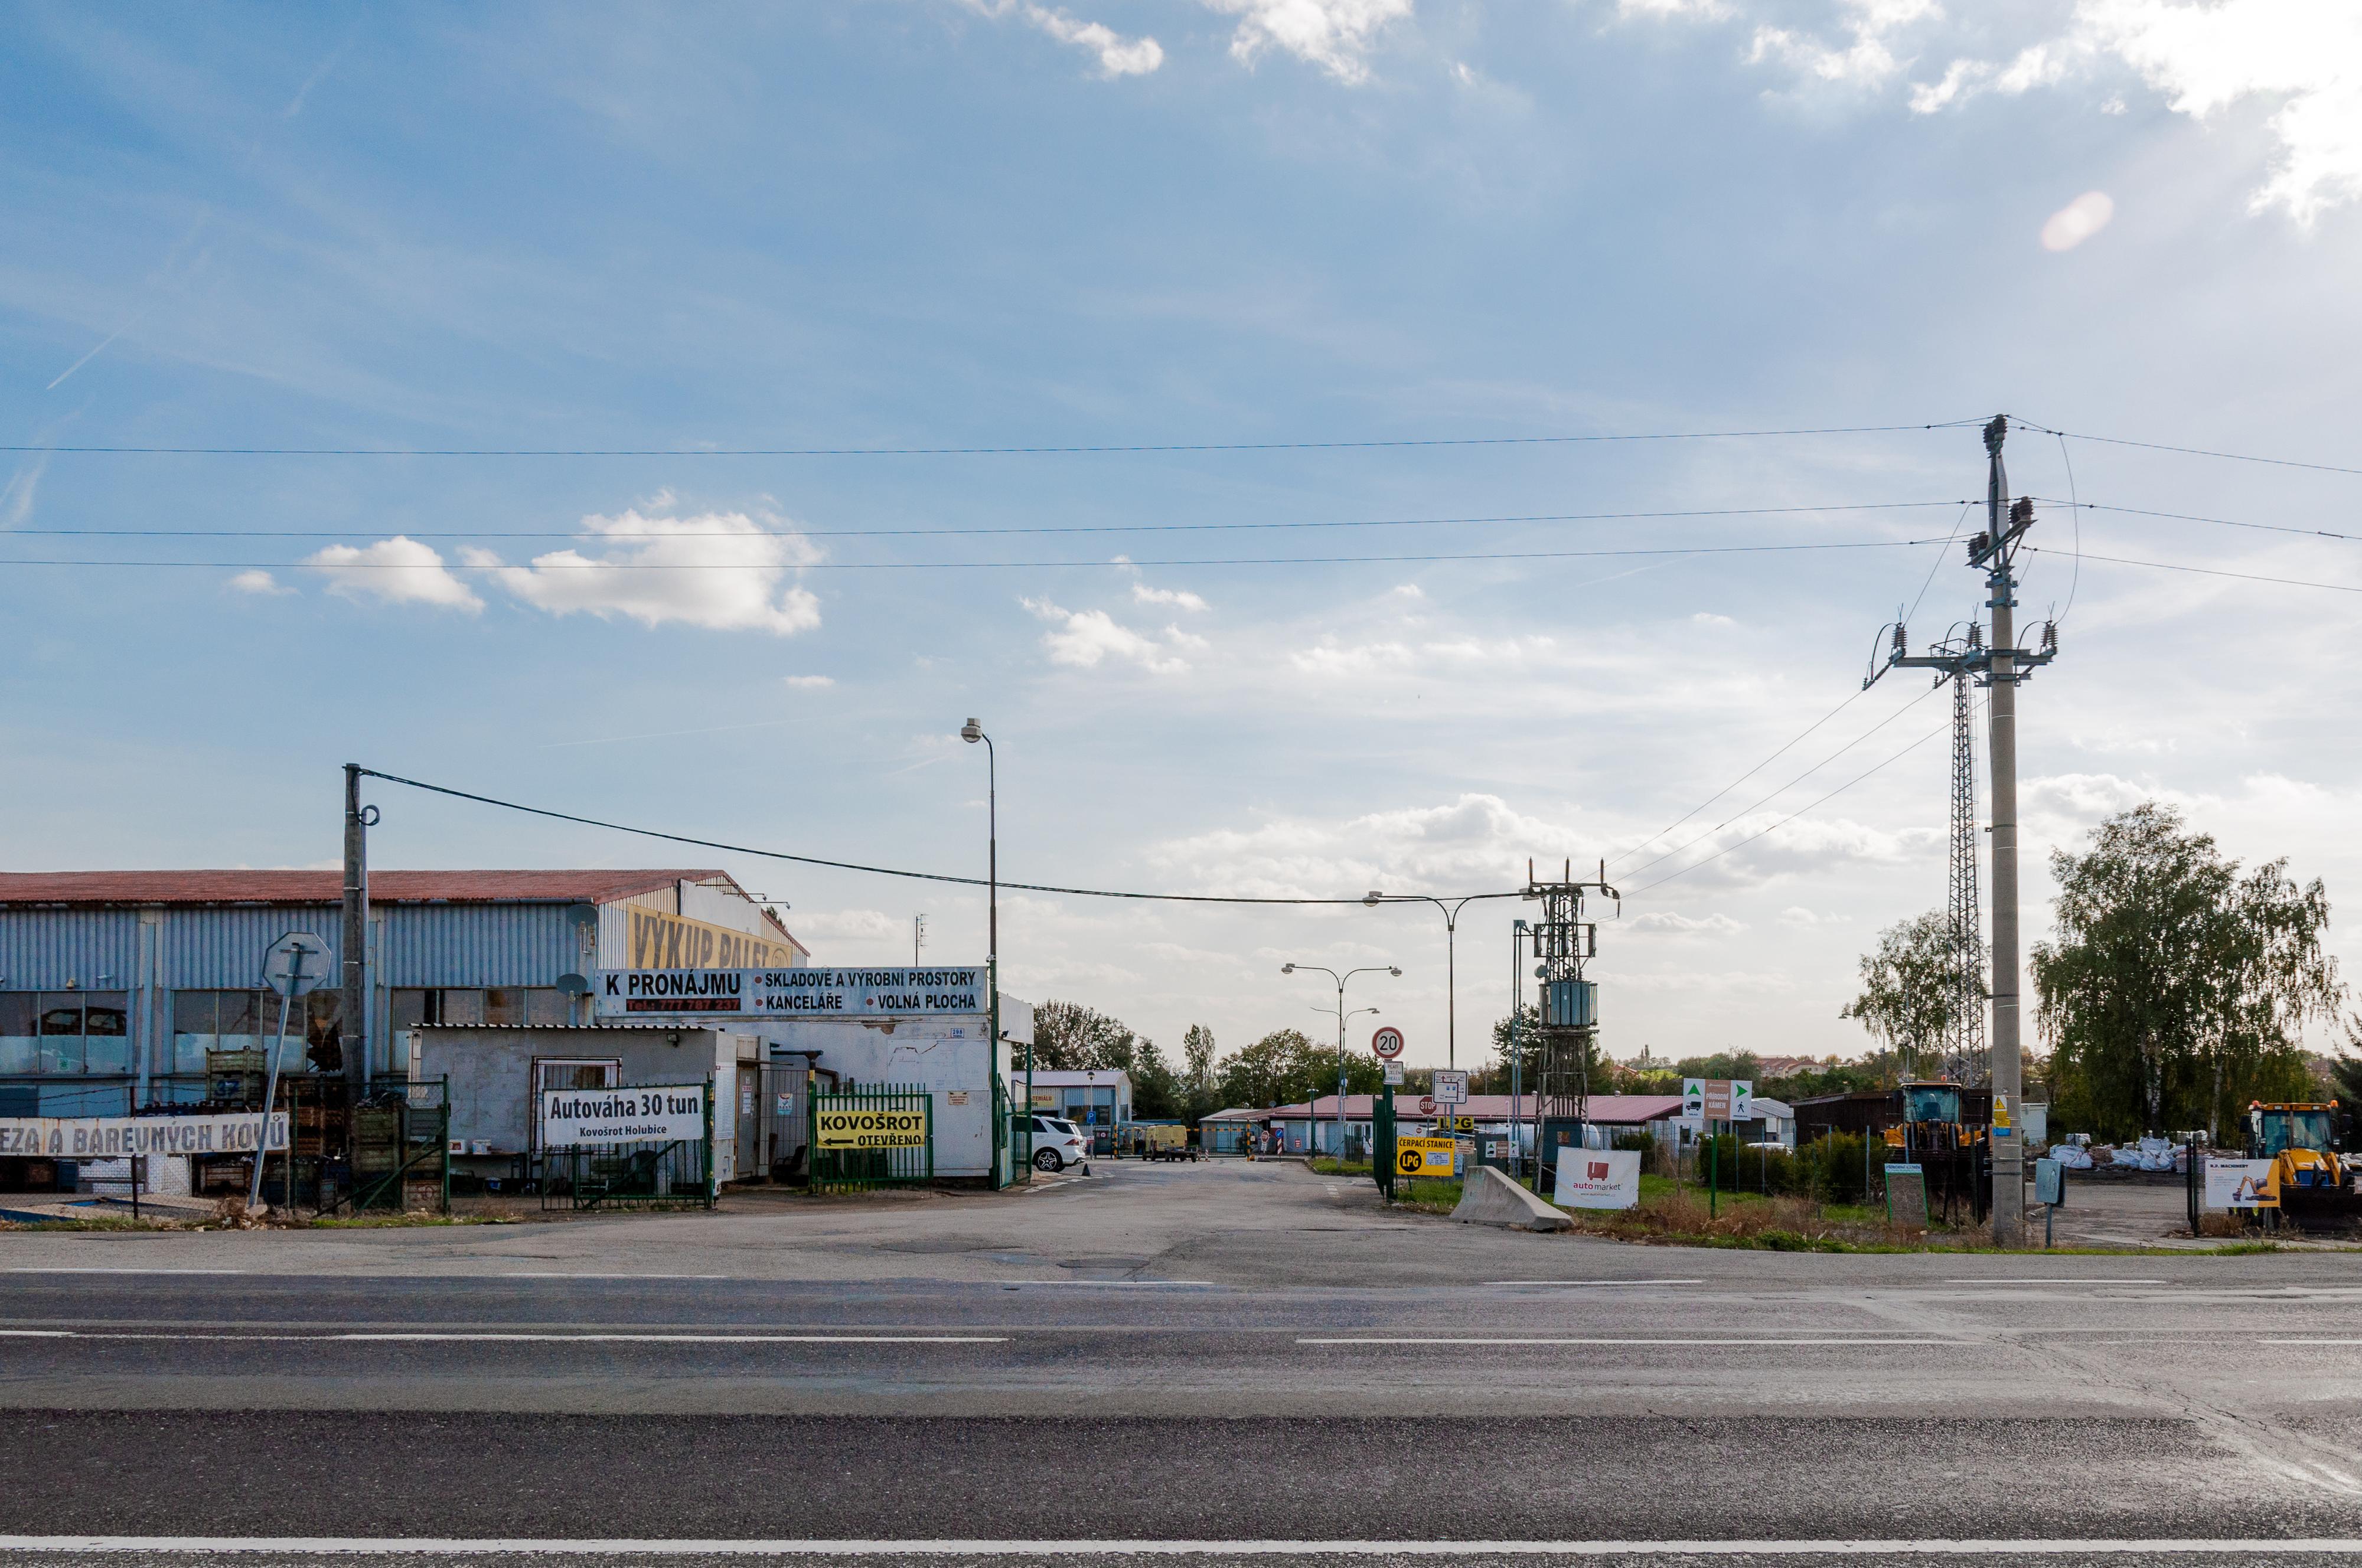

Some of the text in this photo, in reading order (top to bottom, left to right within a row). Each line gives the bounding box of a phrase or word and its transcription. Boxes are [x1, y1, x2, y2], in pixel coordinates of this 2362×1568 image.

[634, 912, 713, 968] VÝKUP
[606, 969, 741, 995] K PRONÁJMU
[765, 969, 976, 987] SKLADOVÉ A VÝROBNÍ PROSTORY
[660, 1000, 683, 1011] 777
[687, 1000, 711, 1011] 787
[715, 999, 739, 1010] 237
[766, 992, 976, 1010] KANCELÁŘE VOLNÁ PLOCHA
[1379, 1035, 1397, 1050] 20
[550, 1093, 698, 1119] Autováha 30 tun
[1420, 1102, 1436, 1110] STOP
[821, 1113, 922, 1131] KOVOŠROT
[0, 1128, 39, 1152] EZA
[49, 1128, 63, 1152] A
[73, 1121, 212, 1153] BAREVNÝCH
[580, 1125, 667, 1137] Kovošrot Holubice
[858, 1133, 921, 1146] OTEVŘENO
[1399, 1138, 1453, 1148] ČERPACÍ STANICE
[1402, 1155, 1419, 1167] LPG
